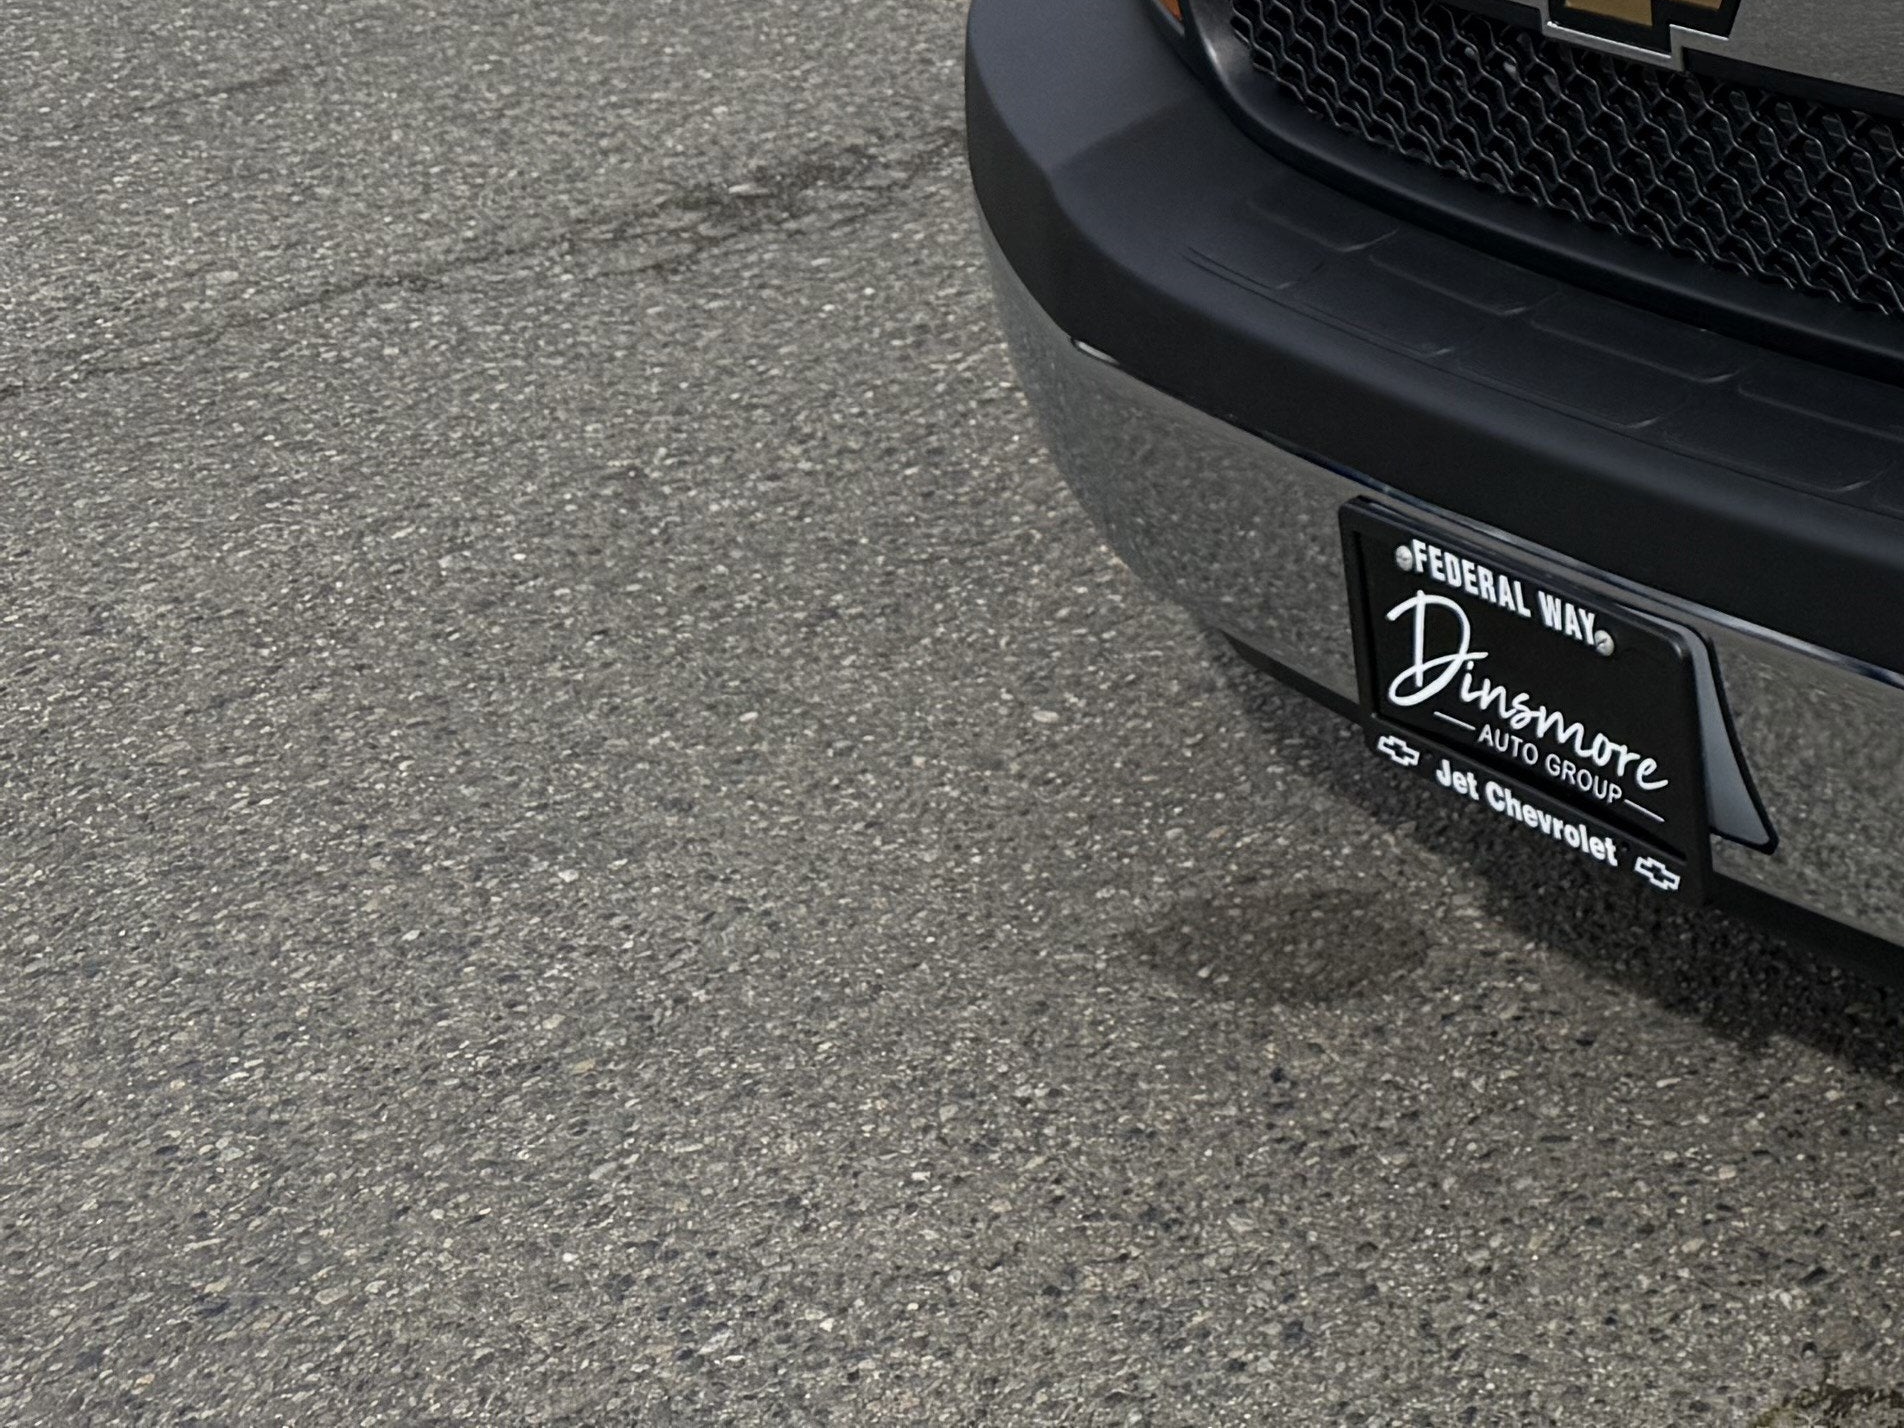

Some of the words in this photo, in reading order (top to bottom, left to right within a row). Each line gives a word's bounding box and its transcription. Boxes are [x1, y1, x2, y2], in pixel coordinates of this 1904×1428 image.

[1411, 539, 1531, 618] FEDERAL
[1538, 591, 1597, 645] WAY
[1386, 590, 1669, 791] Dinsmore
[1435, 760, 1478, 801] Jet
[1486, 779, 1618, 867] Chevrolet
[1477, 725, 1538, 766] AUTO
[1546, 754, 1622, 805] GROUP
